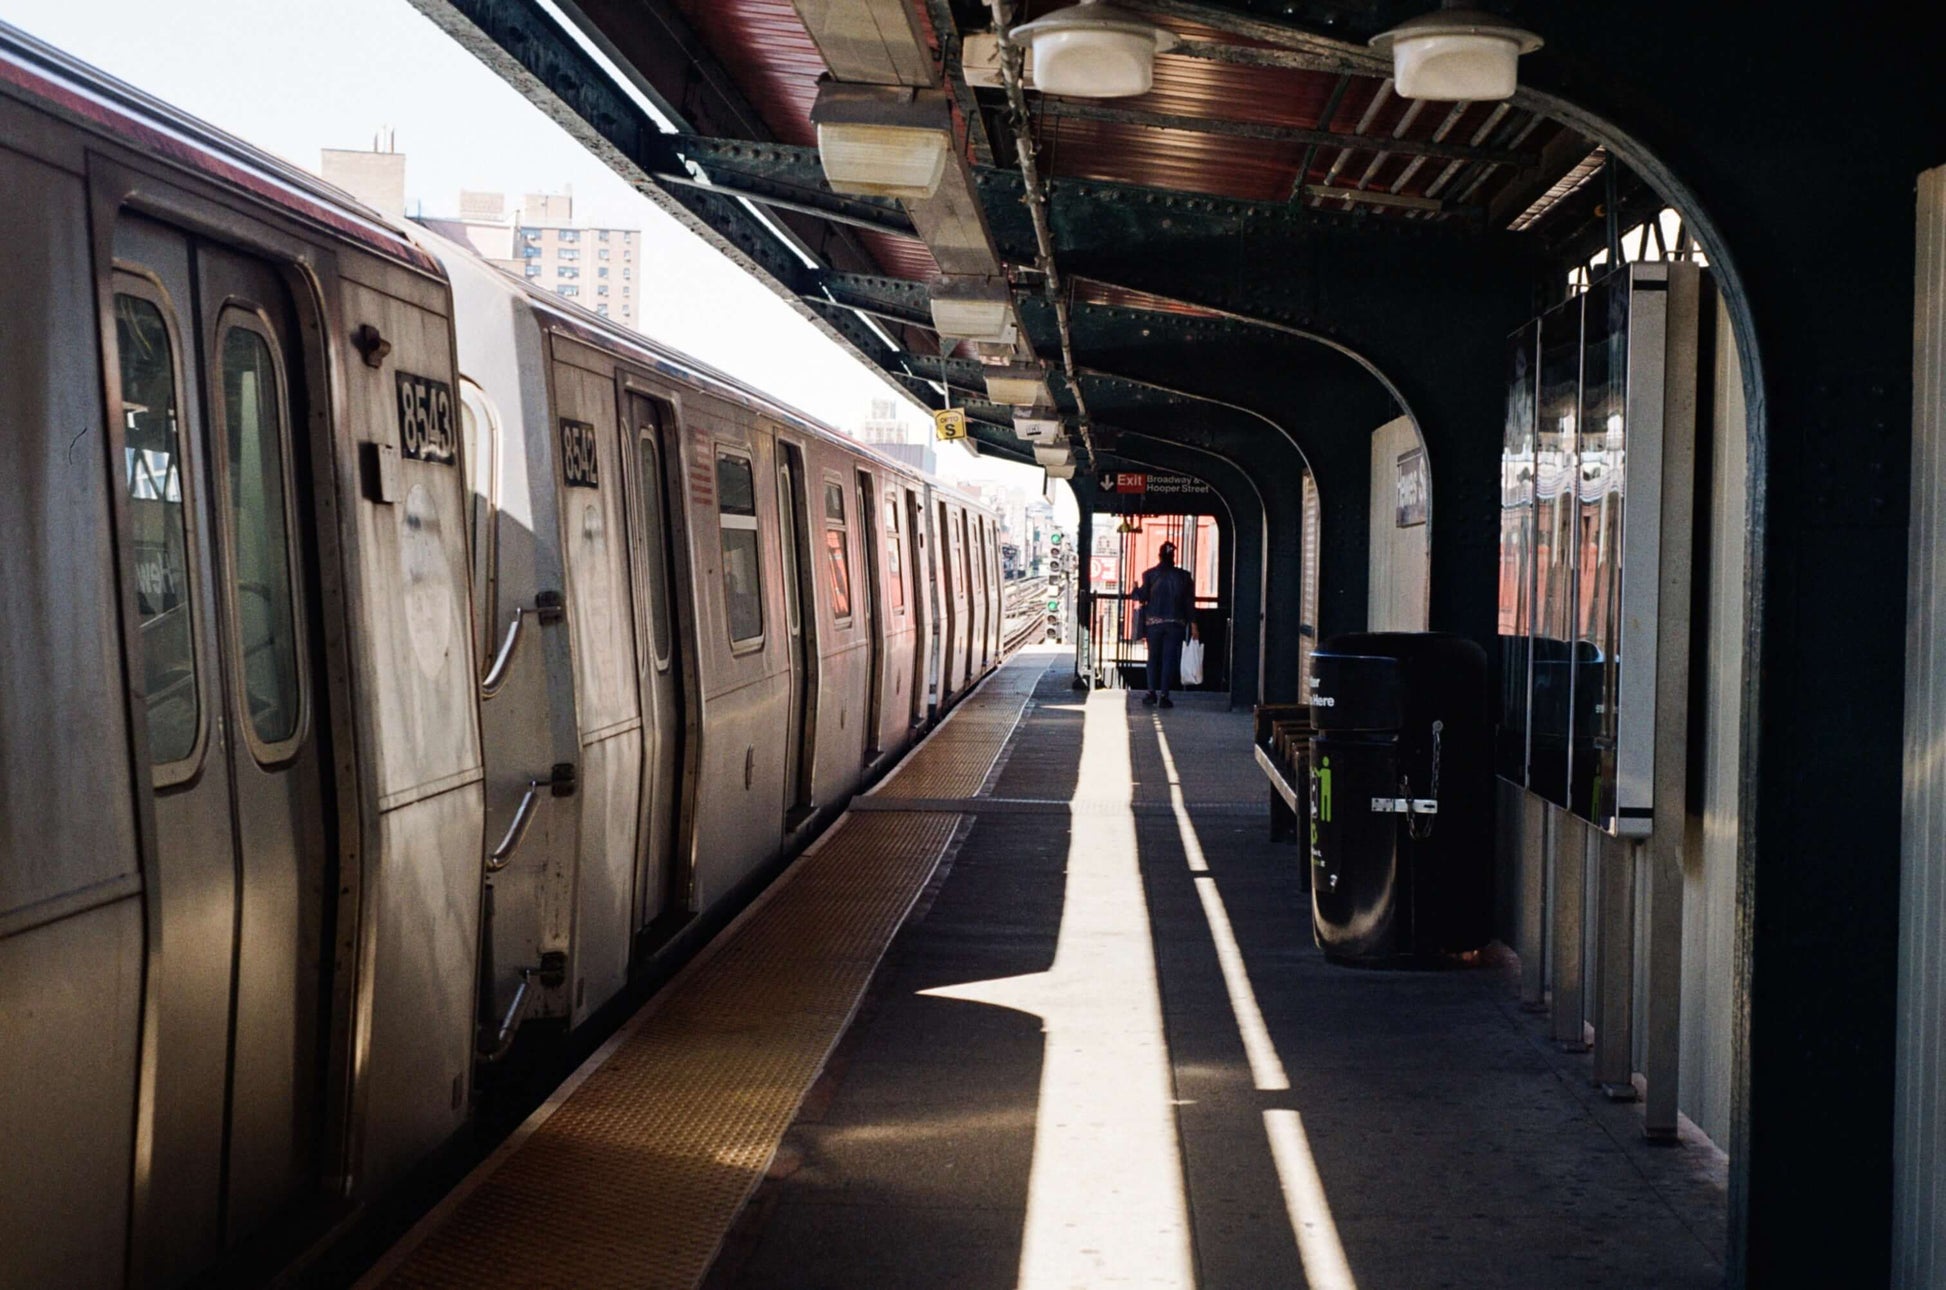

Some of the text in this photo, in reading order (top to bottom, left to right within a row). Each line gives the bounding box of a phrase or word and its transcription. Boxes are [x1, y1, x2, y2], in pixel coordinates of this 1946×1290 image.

[402, 381, 453, 454] 8543
[945, 423, 956, 437] S
[563, 425, 598, 484] 8542
[1117, 474, 1142, 486] Exit
[1146, 475, 1192, 485] Broadway
[1146, 484, 1209, 494] Hooper Street
